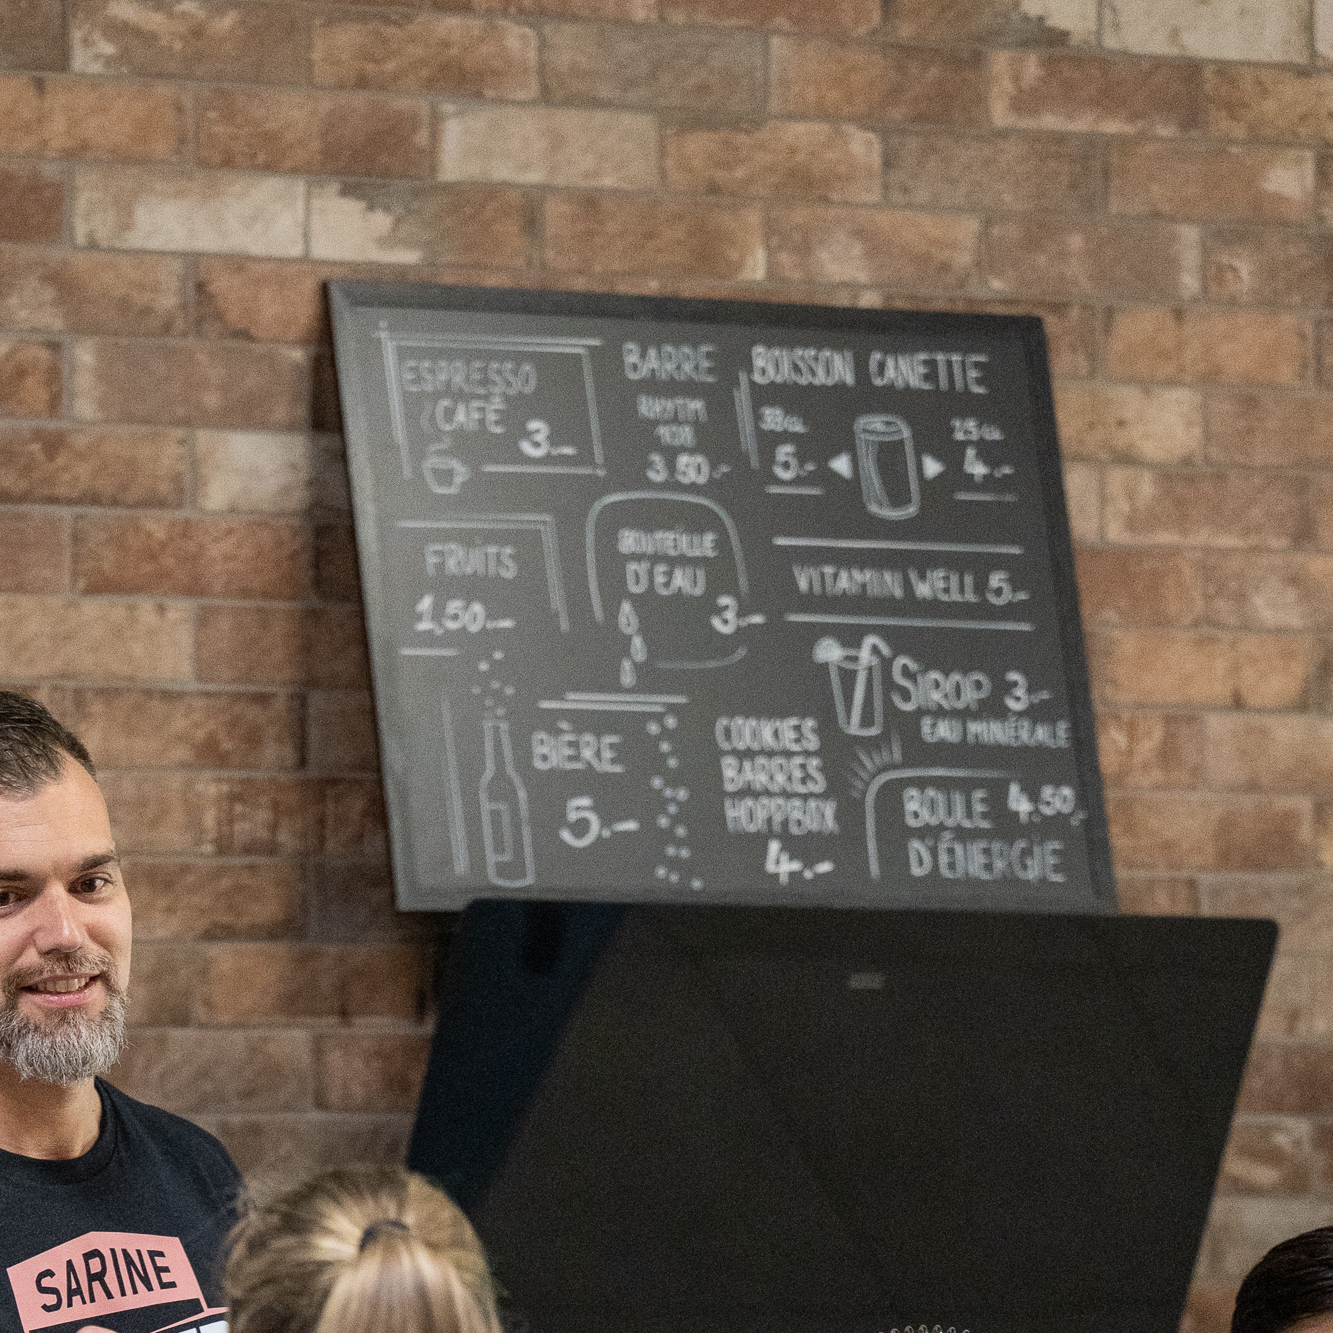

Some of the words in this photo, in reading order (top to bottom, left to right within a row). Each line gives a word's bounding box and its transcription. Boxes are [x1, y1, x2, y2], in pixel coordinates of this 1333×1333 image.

[402, 360, 538, 394] ESPRESSO
[622, 342, 717, 382] BARRE
[752, 344, 856, 387] BOISSON
[870, 351, 989, 394] CANETTE
[435, 394, 507, 434] CAFÉ
[425, 536, 517, 579] FRUITS
[792, 564, 905, 599] VITAMIN
[908, 567, 980, 603] WELL
[531, 720, 626, 773] BIÈRE
[716, 716, 821, 751] COOKIES
[920, 714, 964, 744] EAU
[965, 711, 1072, 748] MINÉRALE
[719, 754, 827, 794] BARRES
[902, 785, 994, 829] BOULE
[35, 1247, 178, 1314] SARINE
